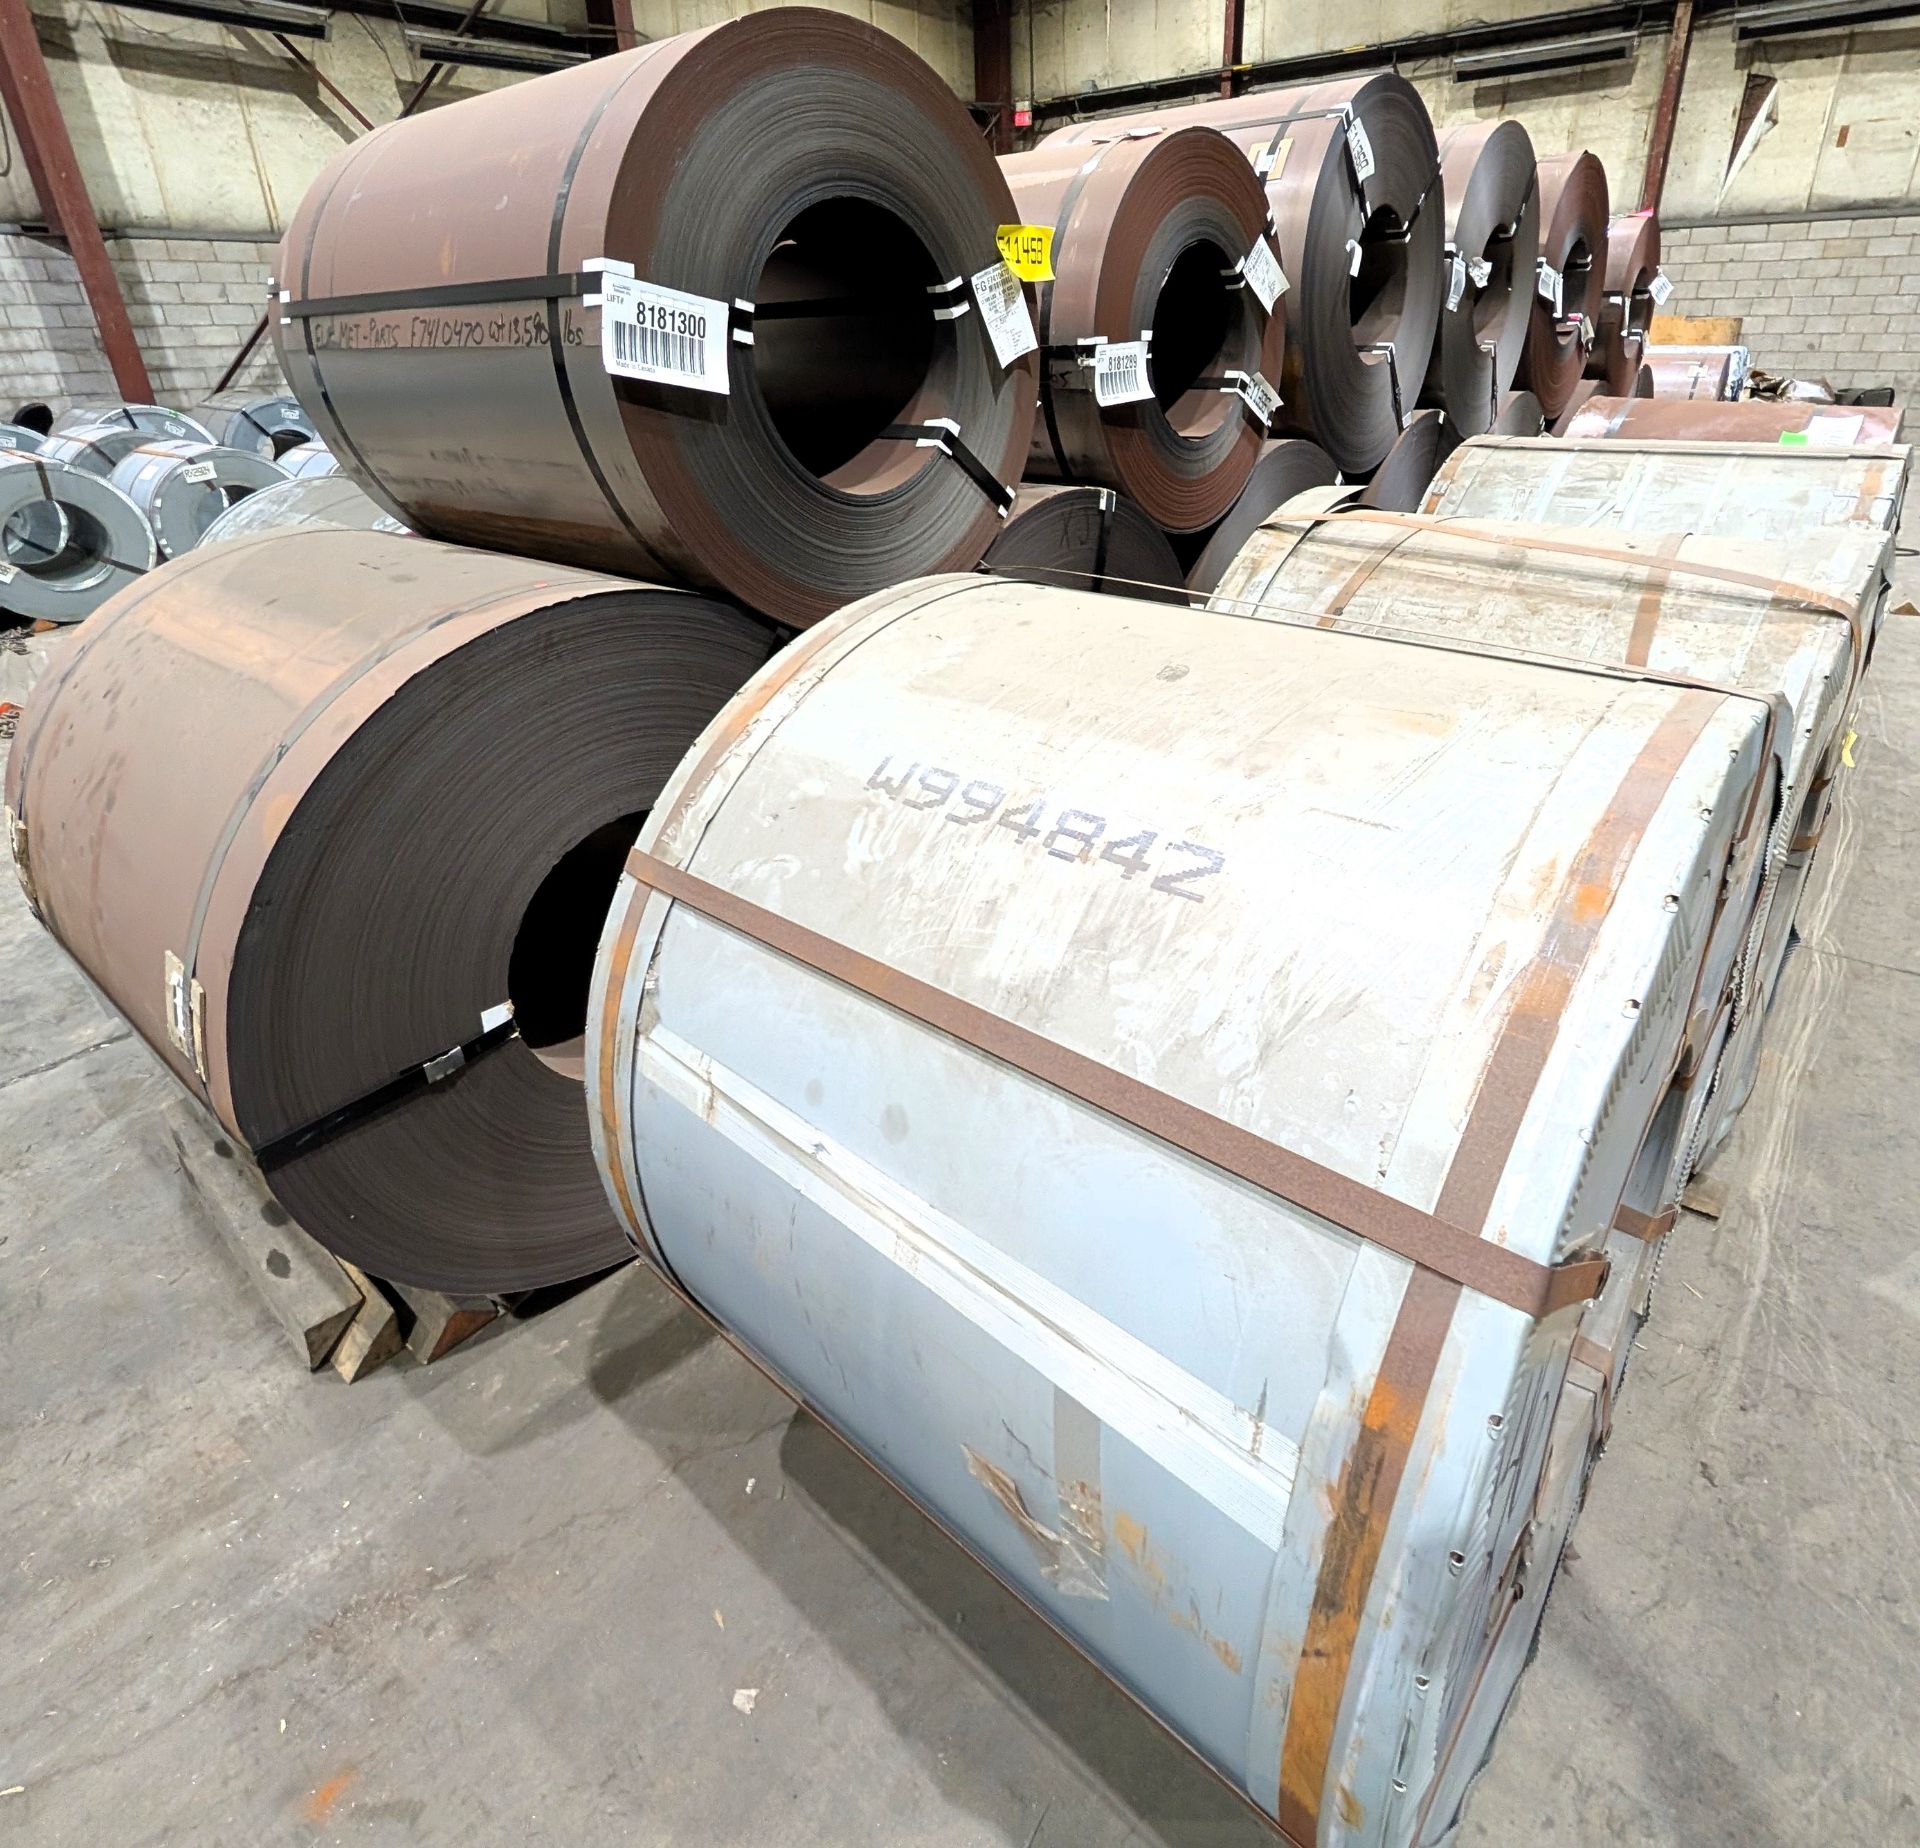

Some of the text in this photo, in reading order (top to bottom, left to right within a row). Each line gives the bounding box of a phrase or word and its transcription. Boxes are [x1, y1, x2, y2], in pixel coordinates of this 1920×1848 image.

[563, 309, 584, 346] lbs
[636, 301, 706, 339] 8181300
[863, 754, 1226, 904] W994842
